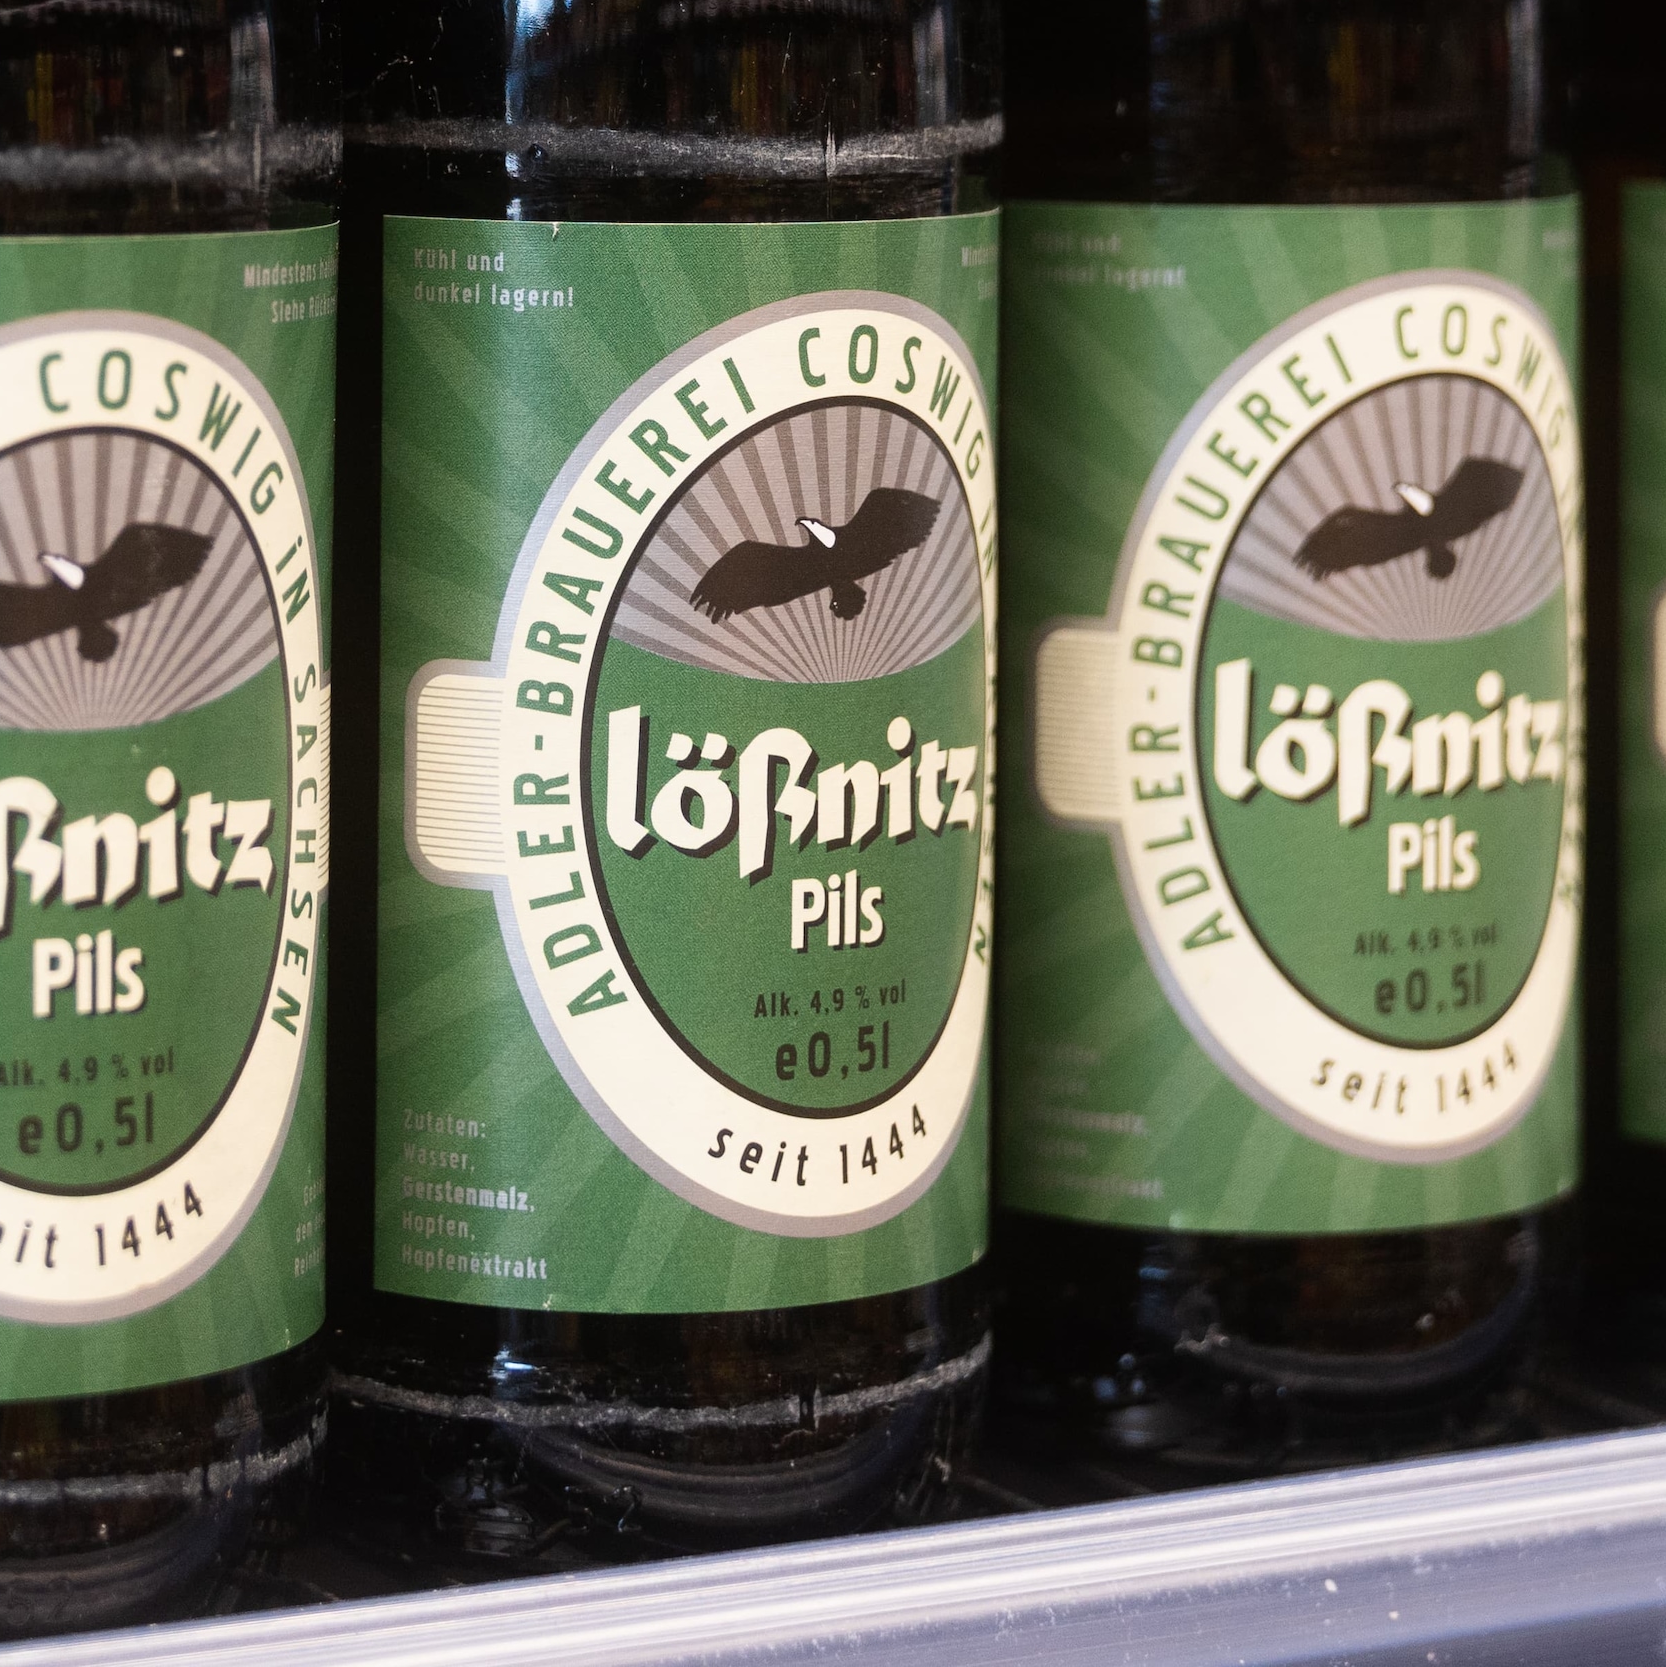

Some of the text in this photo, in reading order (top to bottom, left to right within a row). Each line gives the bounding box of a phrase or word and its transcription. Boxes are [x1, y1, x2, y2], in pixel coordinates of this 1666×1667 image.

[414, 248, 504, 272] Kühl und
[414, 281, 574, 313] dunkel lagern!
[513, 358, 756, 1017] ADLER-BRAUEREI
[798, 324, 986, 480] COSWIG
[1128, 332, 1354, 957] ADLER-BRAUEREI
[39, 347, 284, 516] COSWIG
[271, 662, 318, 1037] SACHSEN
[1214, 658, 1564, 826] lößnitz
[606, 705, 978, 887] lößnitz
[1386, 815, 1481, 894] Pils
[790, 870, 885, 953] Pils
[33, 929, 146, 1020] Pils
[754, 991, 798, 1018] Alk.
[855, 985, 870, 1010] %
[879, 978, 906, 1006] vol
[1311, 1039, 1519, 1115] seit 1444
[403, 1142, 475, 1173] Wasser,
[404, 1109, 486, 1138] Zutaten:
[707, 1103, 927, 1186] seit 1444
[94, 1179, 204, 1268] 1444
[402, 1210, 476, 1241] Hopfen,
[403, 1175, 535, 1213] Gerstenmalz,
[401, 1243, 548, 1280] Hopfenextrakt
